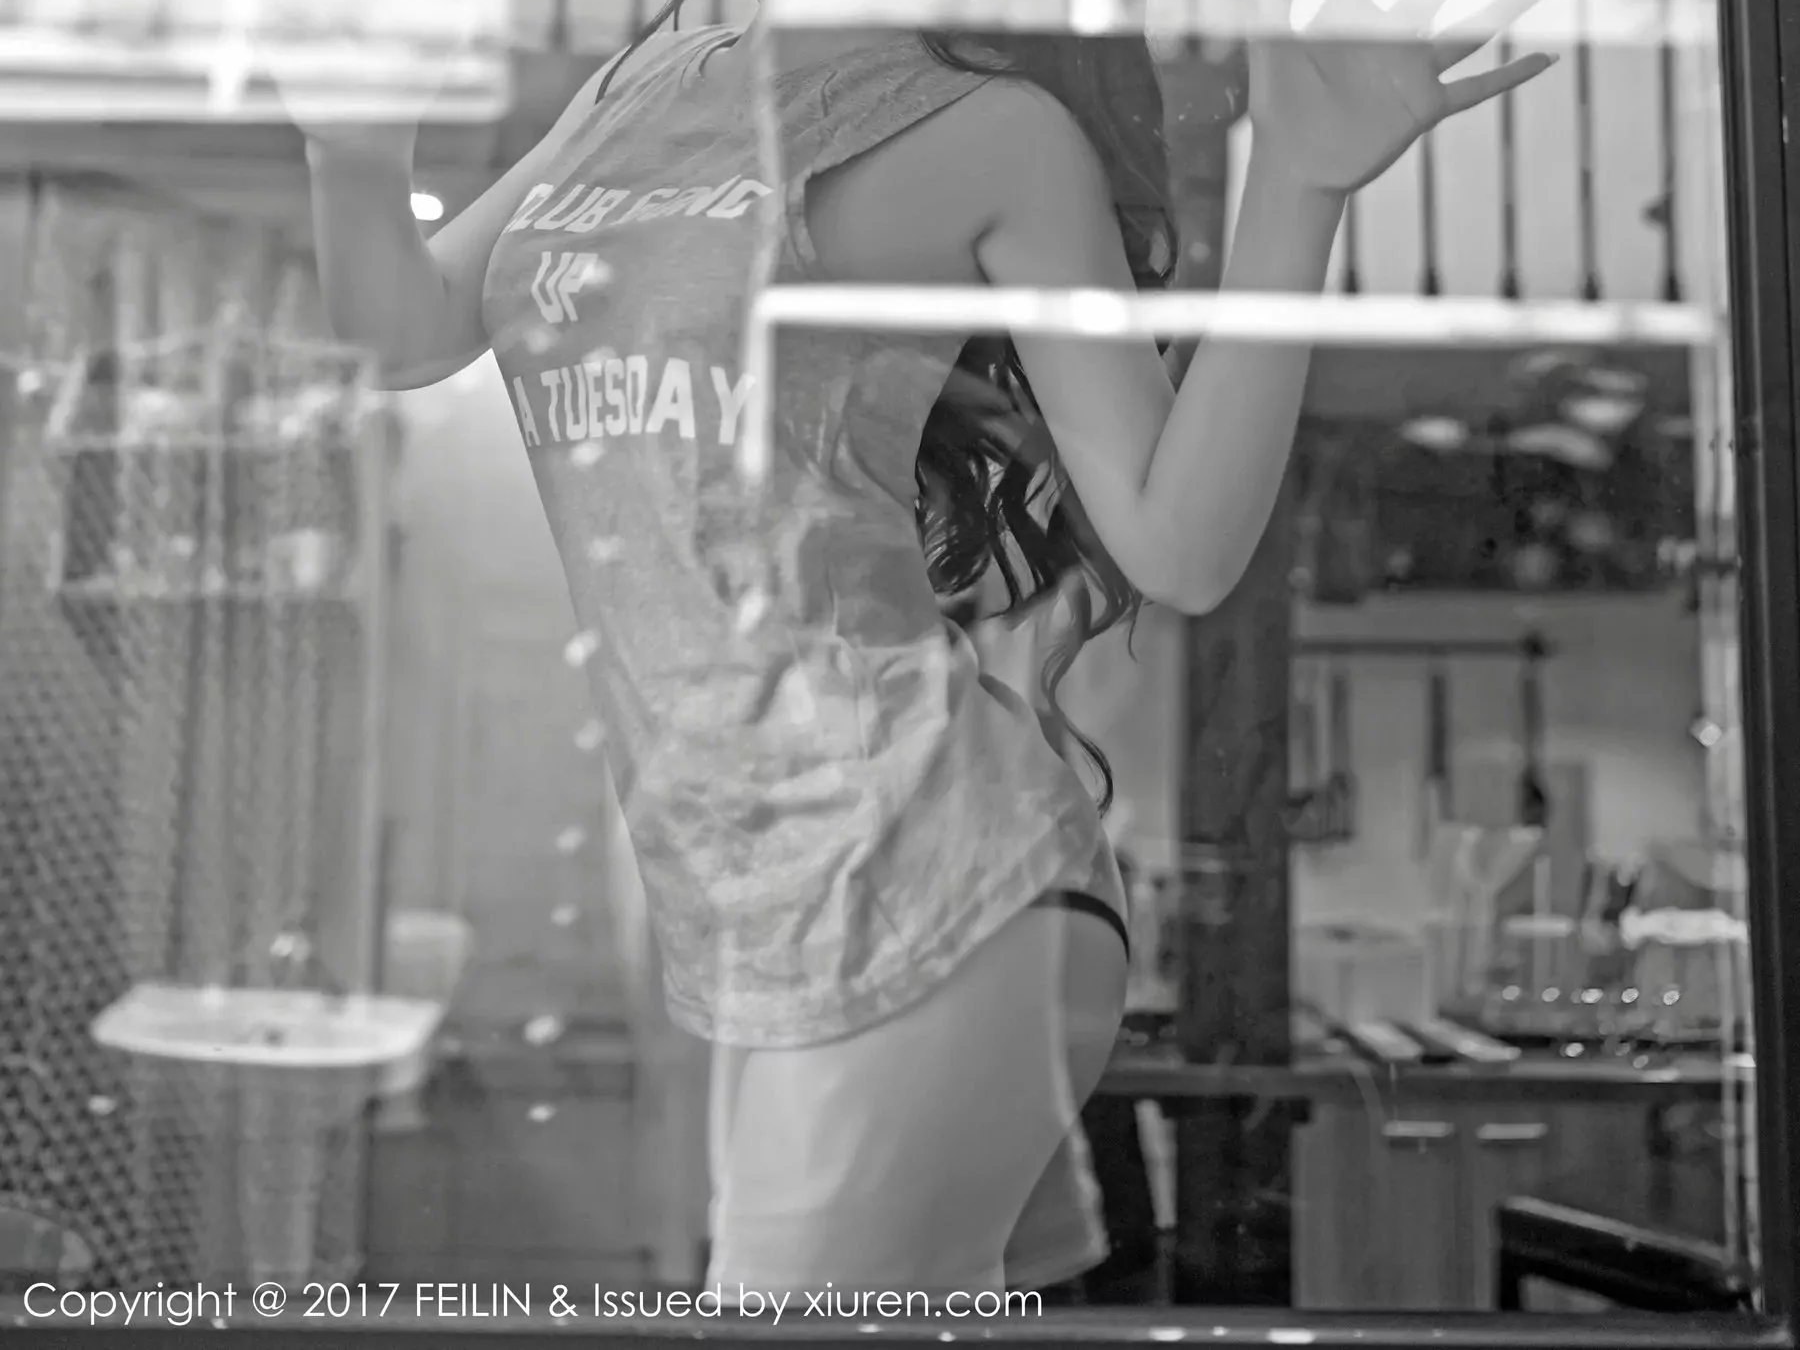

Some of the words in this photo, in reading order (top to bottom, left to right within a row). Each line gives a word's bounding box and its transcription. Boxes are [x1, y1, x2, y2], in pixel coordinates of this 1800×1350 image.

[531, 250, 600, 324] UP
[513, 376, 541, 447] A
[540, 354, 757, 446] TUESDAY
